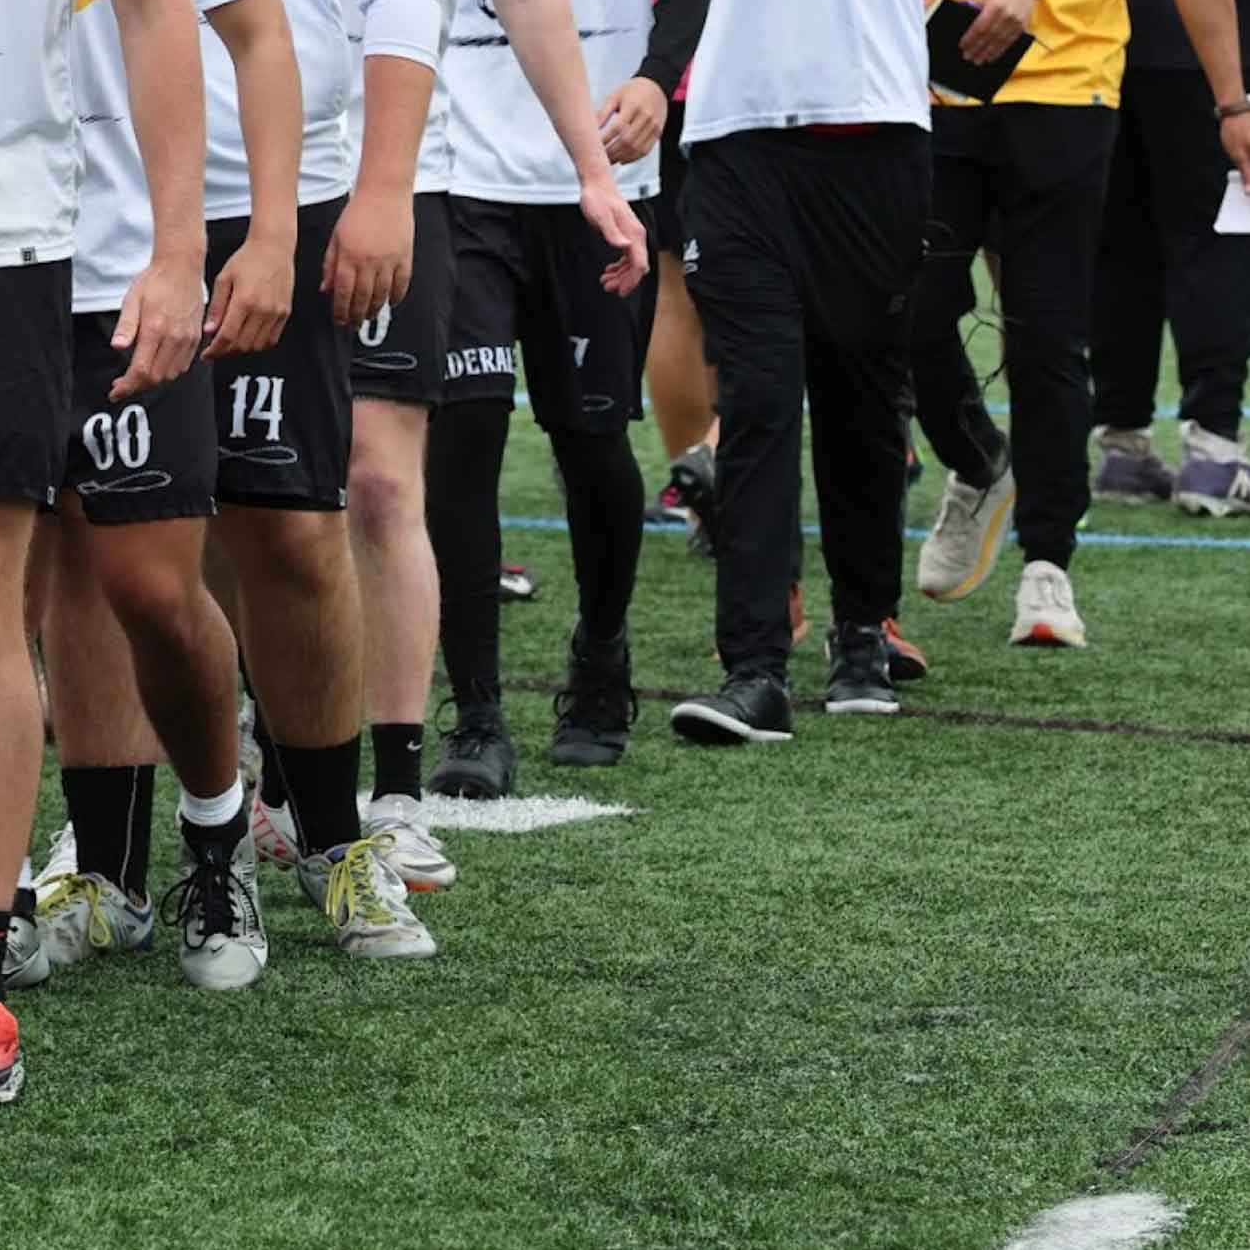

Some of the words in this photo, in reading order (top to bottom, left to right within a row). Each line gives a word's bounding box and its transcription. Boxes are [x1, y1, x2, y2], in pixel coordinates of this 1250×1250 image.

[444, 347, 517, 380] DERAL
[83, 404, 151, 470] 00
[230, 375, 285, 440] 14
